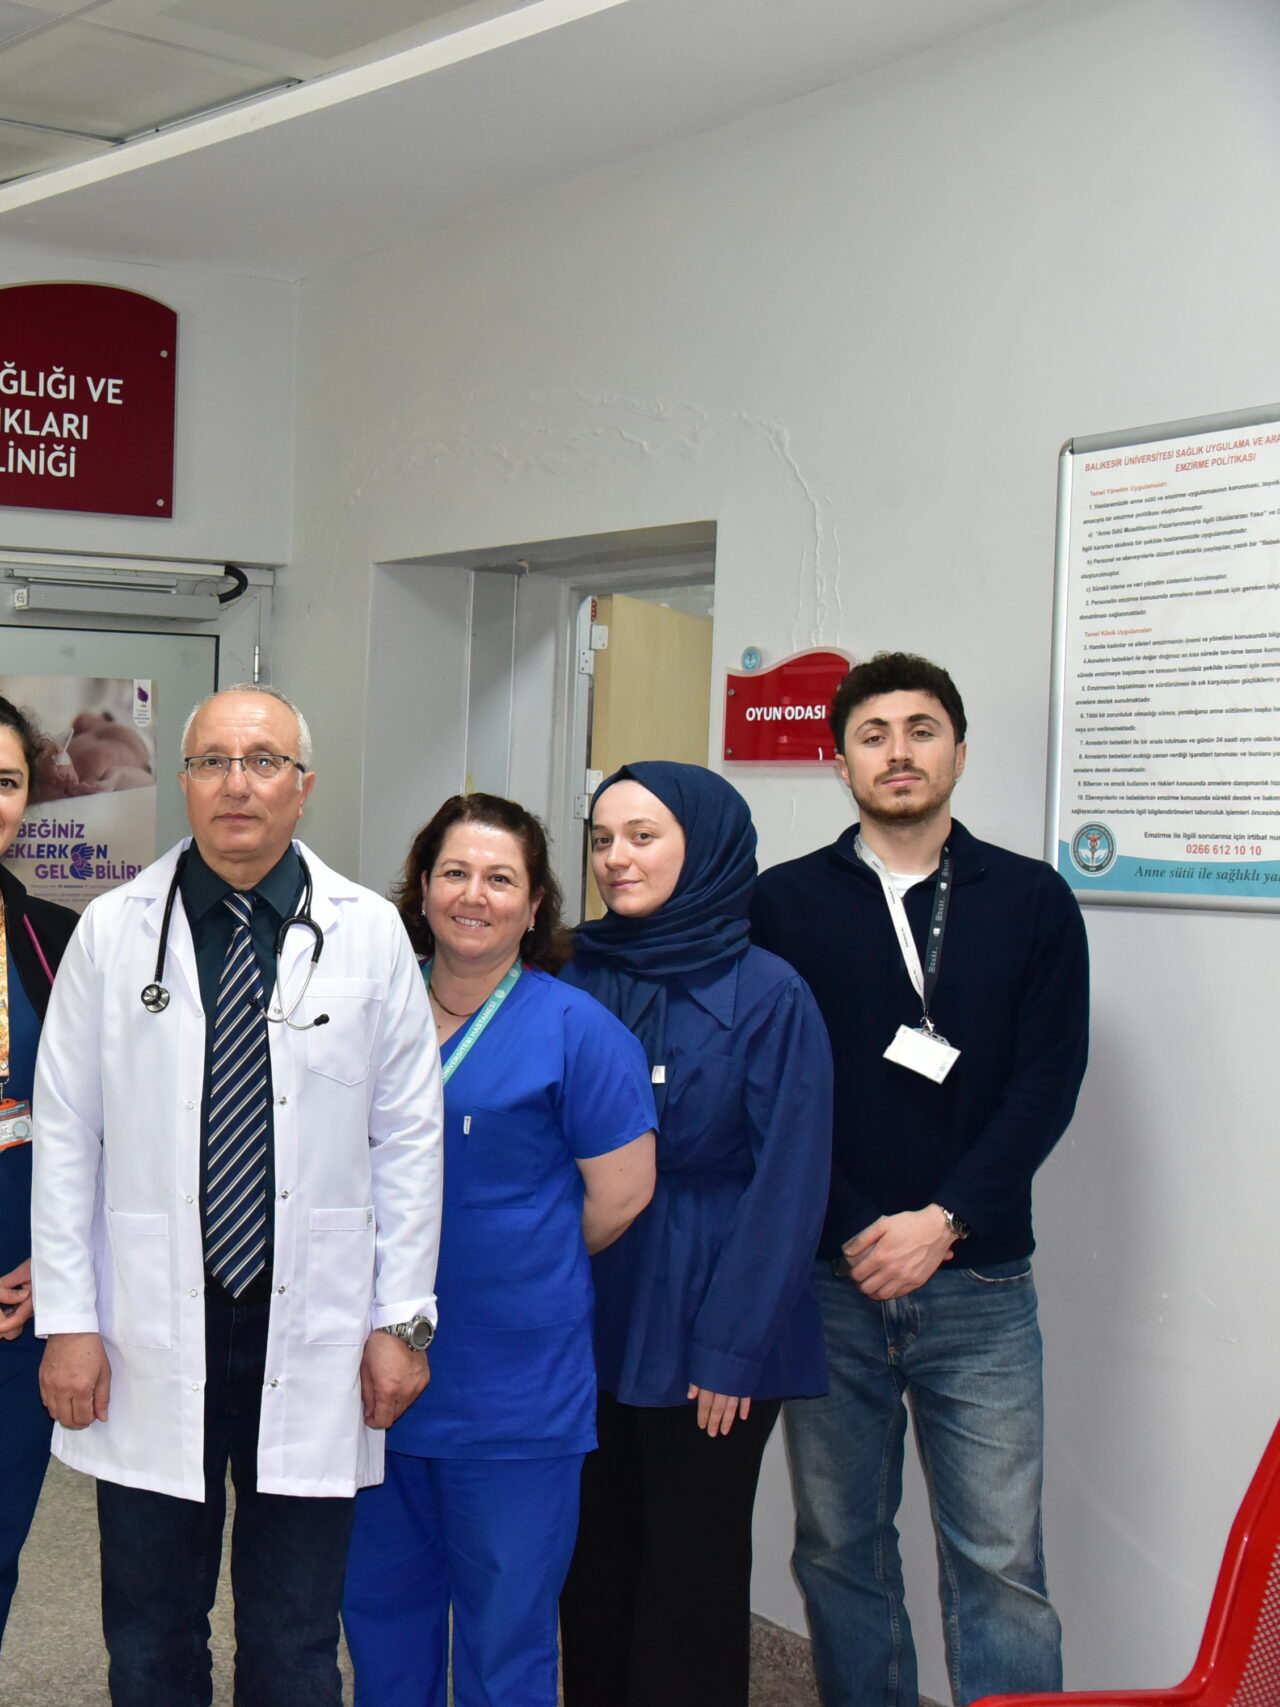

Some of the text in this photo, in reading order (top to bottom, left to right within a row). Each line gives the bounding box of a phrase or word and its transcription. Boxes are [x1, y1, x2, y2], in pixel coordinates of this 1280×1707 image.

[86, 377, 124, 405] VE
[1175, 444, 1202, 457] SAĞLIK
[1205, 438, 1249, 453] UYGULAMA
[1252, 436, 1263, 446] VE
[1175, 458, 1208, 471] EMZİRME
[745, 705, 826, 721] OYUN ODASI
[17, 819, 85, 839] BEĞİNİZ
[1183, 832, 1196, 840] ilgili
[1186, 843, 1261, 855] 0266 612 10 10
[1134, 866, 1280, 885] Anne sütü ile sağlıklı ya
